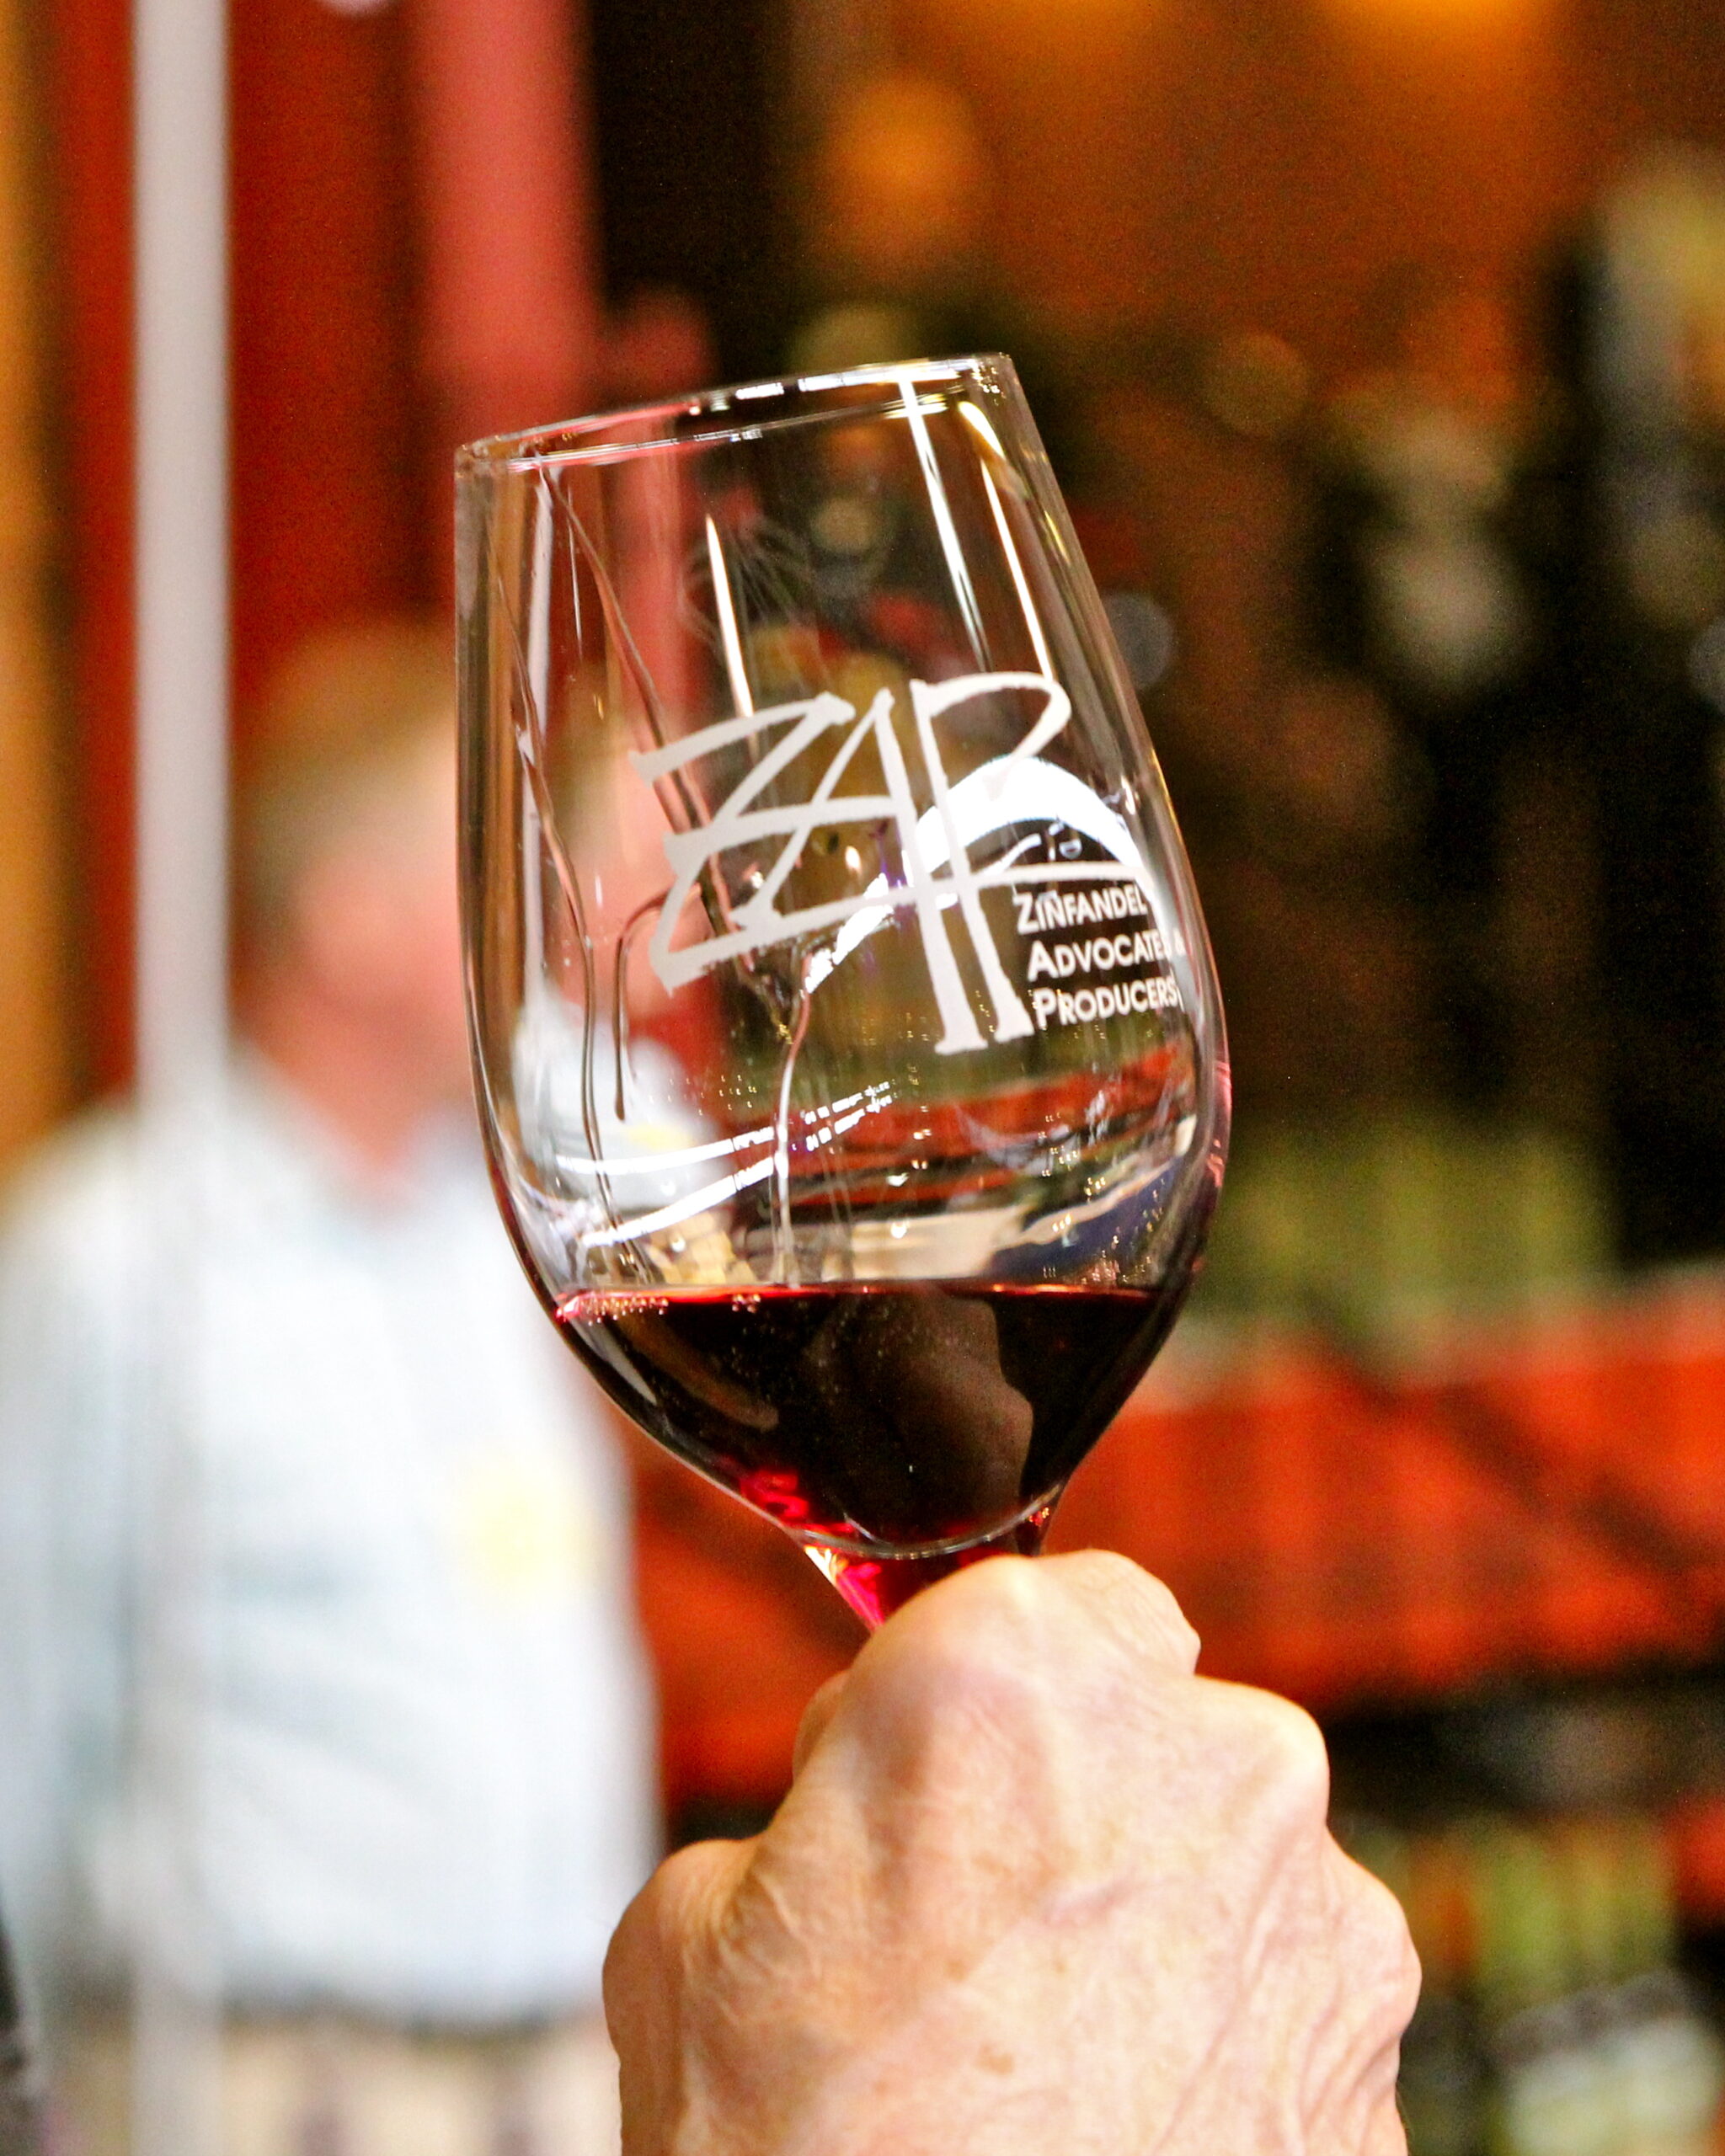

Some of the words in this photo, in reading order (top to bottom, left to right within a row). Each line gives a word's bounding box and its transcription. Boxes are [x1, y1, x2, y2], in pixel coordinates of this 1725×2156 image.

[628, 671, 1078, 1055] ZAP
[1013, 884, 1147, 935] ZINFANDEL
[1032, 974, 1178, 1031] PRODUCERS
